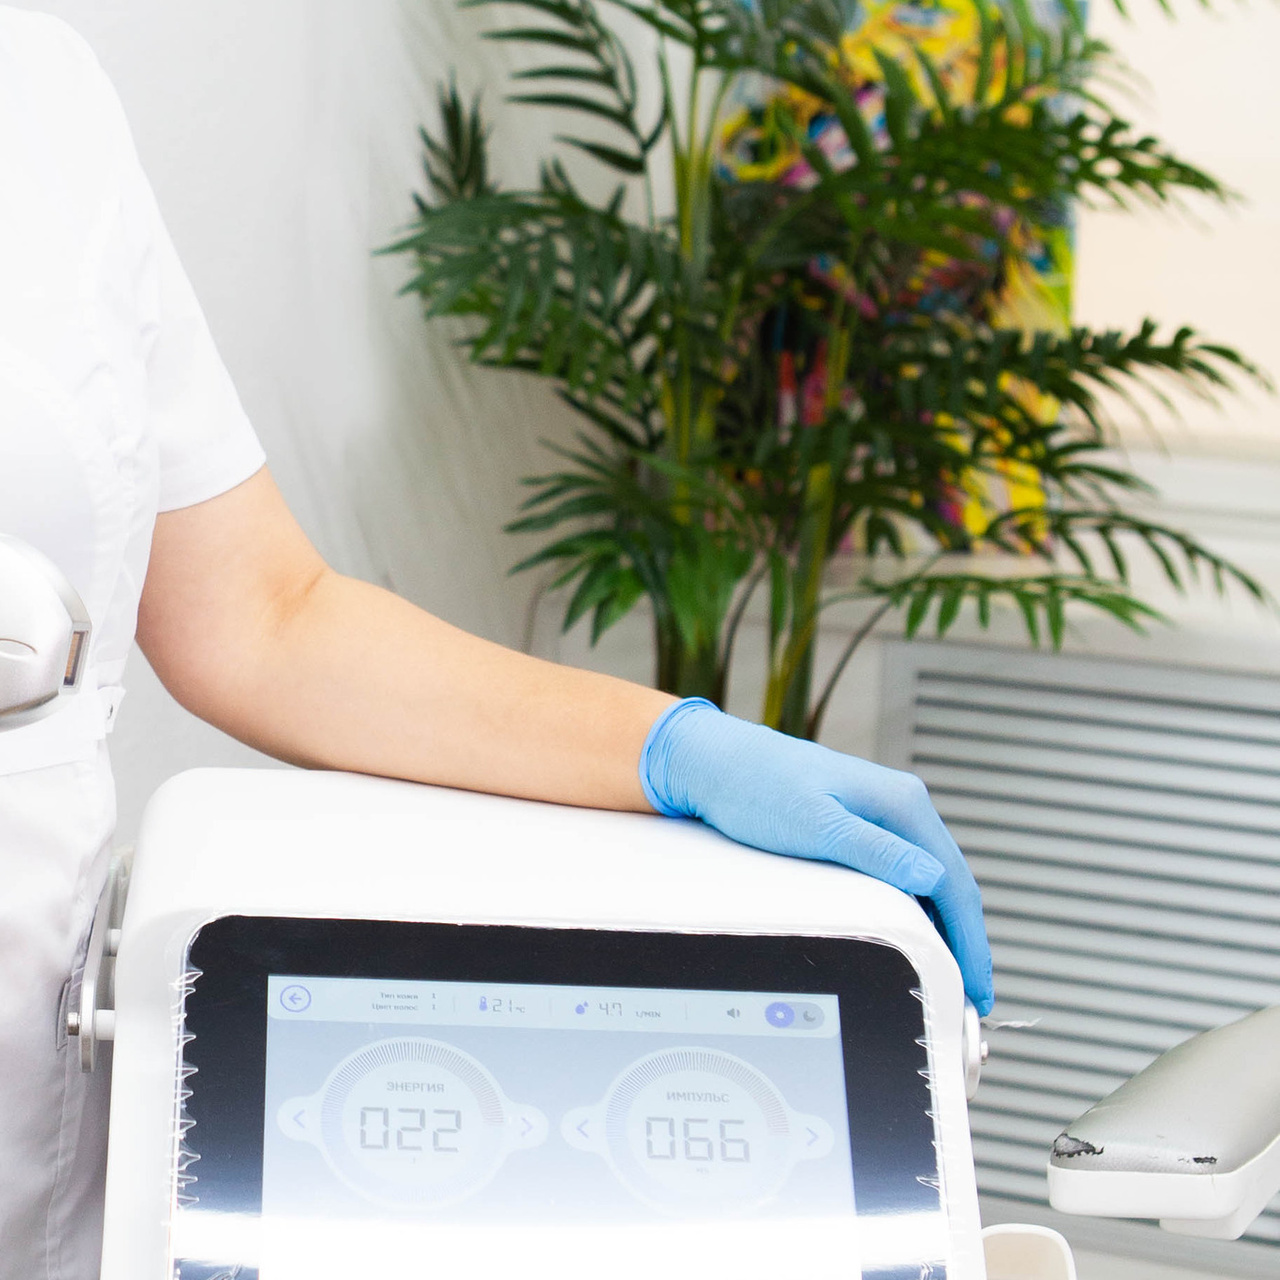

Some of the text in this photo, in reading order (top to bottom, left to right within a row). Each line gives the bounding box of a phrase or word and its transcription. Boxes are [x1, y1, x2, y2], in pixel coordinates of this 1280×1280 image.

[386, 1080, 445, 1094] ЭНЕРГИЯ
[665, 1090, 731, 1104] ИМПУЛЬС
[359, 1106, 462, 1153] 022
[645, 1116, 751, 1163] 066
